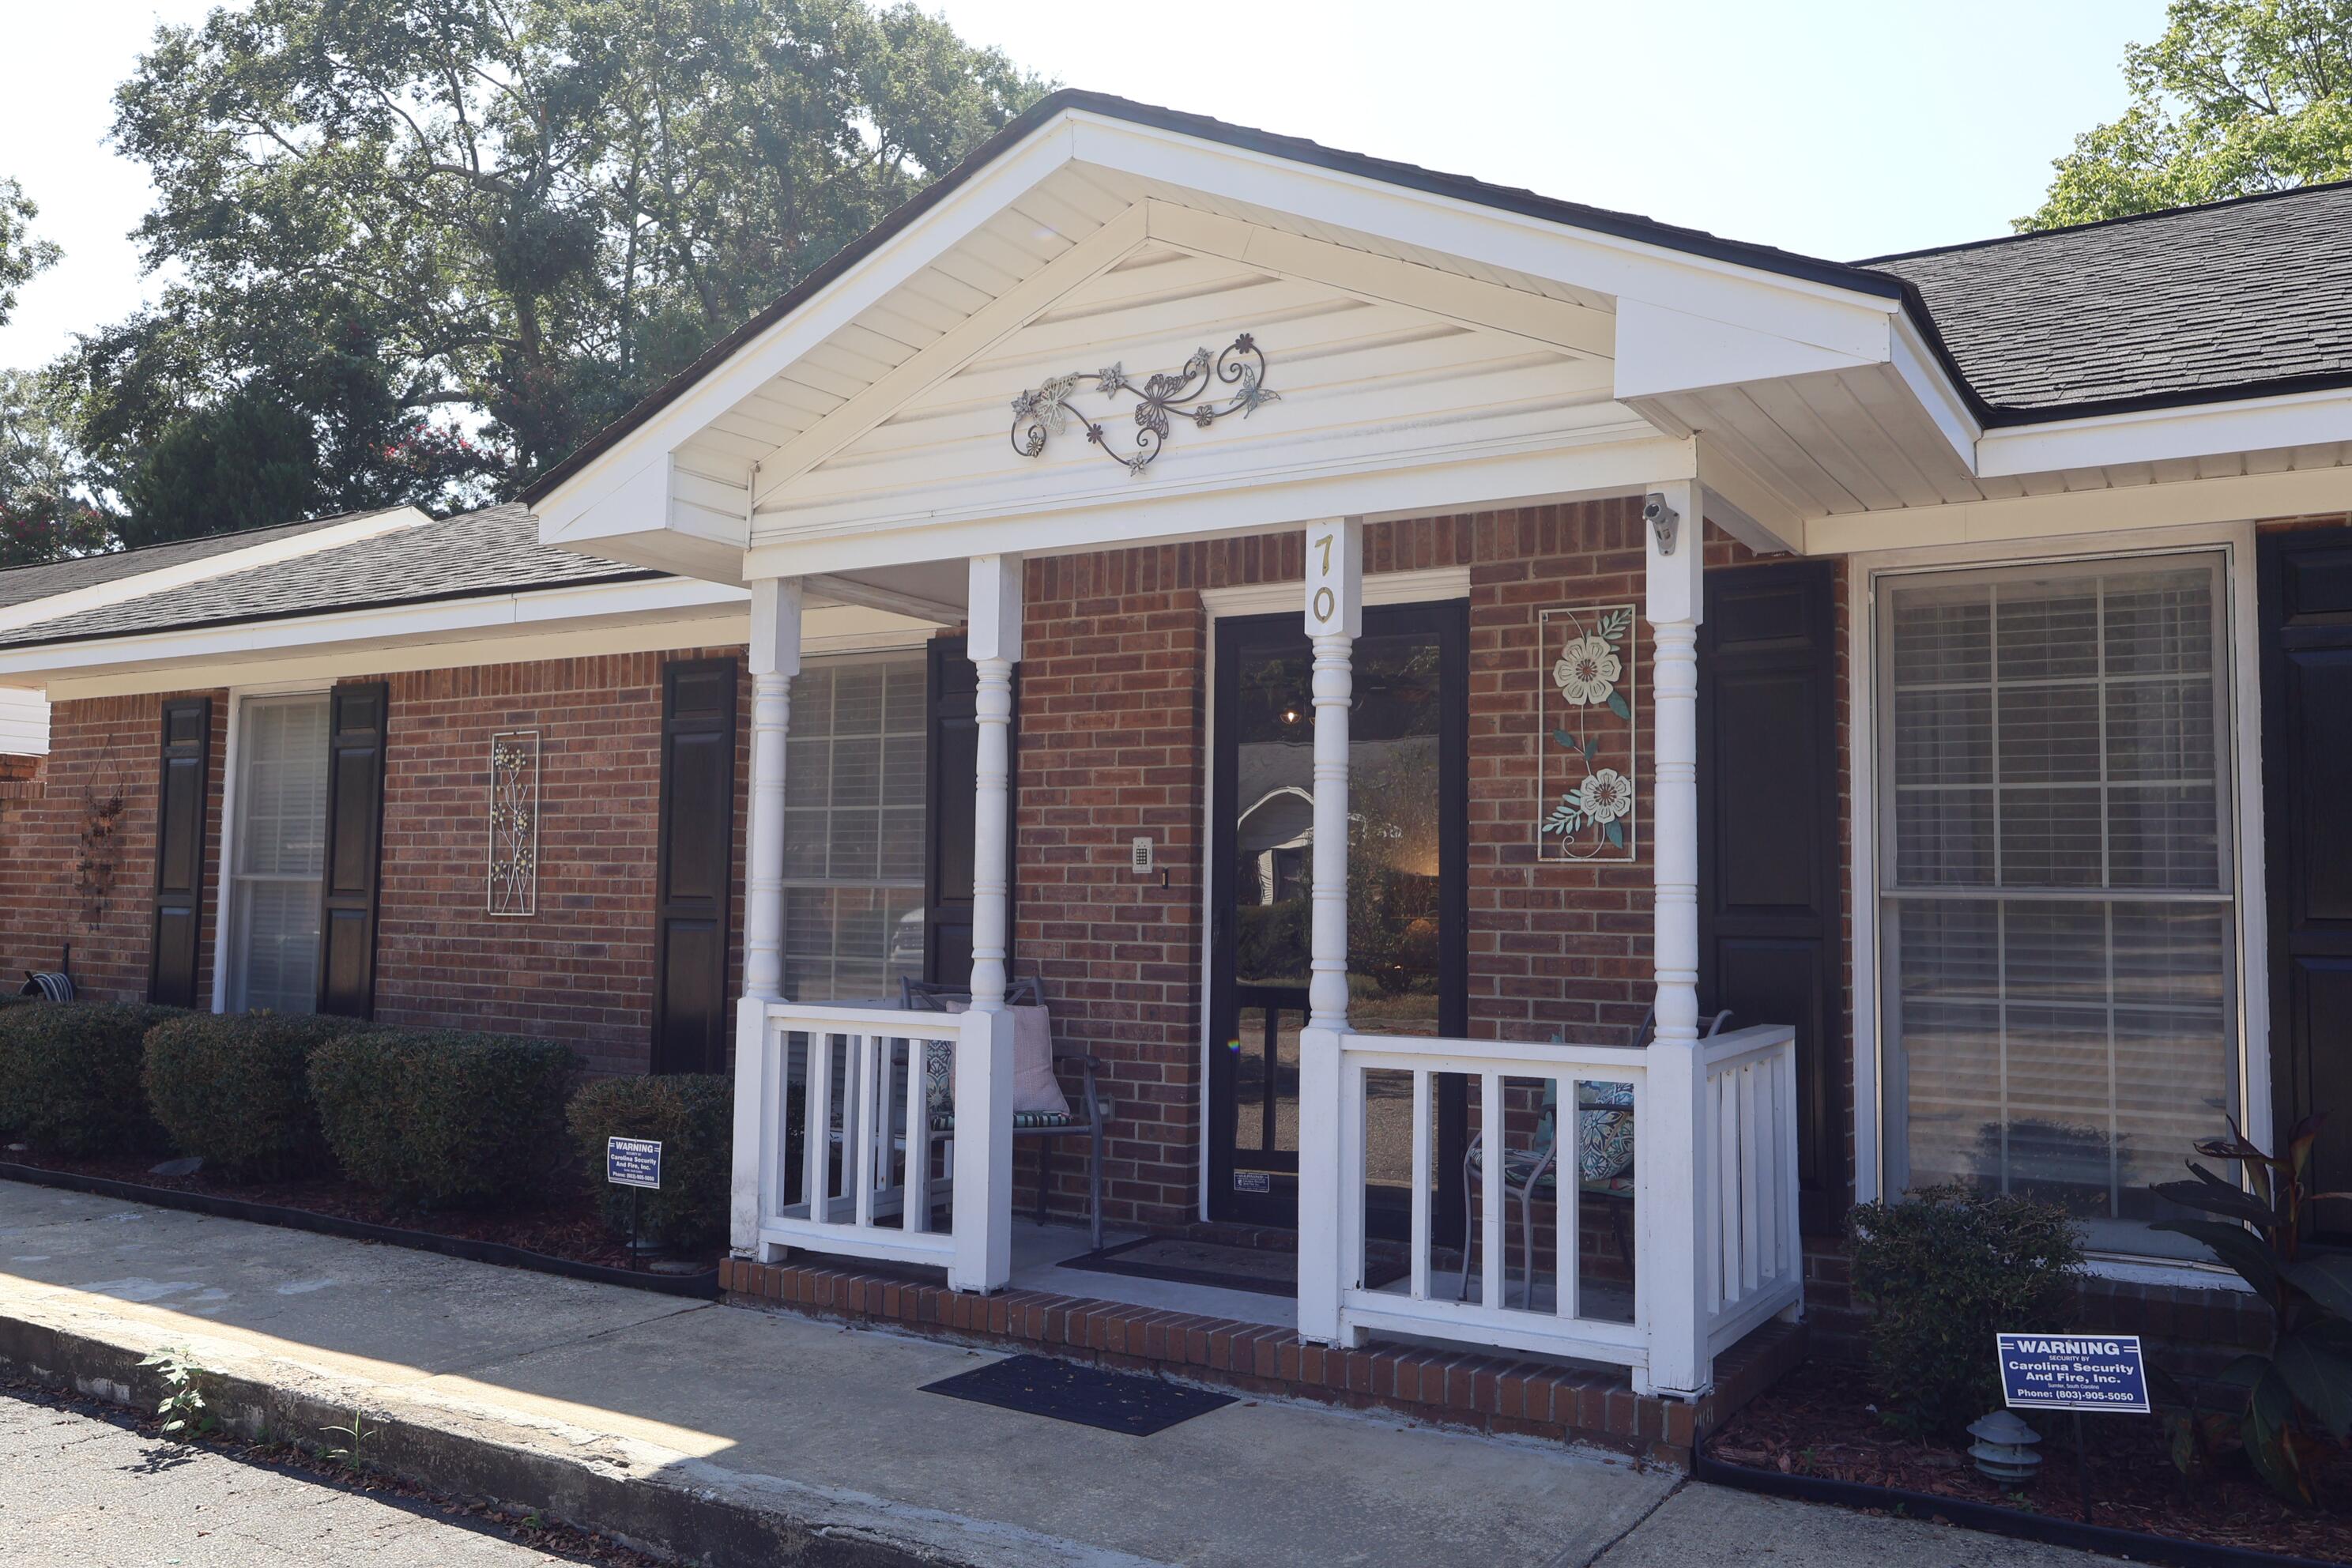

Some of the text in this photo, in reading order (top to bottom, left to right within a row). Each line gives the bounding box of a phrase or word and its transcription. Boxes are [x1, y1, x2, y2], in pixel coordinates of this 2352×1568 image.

[1314, 534, 1334, 624] 70
[616, 1141, 653, 1153] WARNING
[2017, 1340, 2120, 1355] WARNING
[2009, 1361, 2134, 1375] Carolina Security
[2058, 1374, 2089, 1383] Fire,
[2094, 1374, 2120, 1383] Inc.
[2056, 1390, 2134, 1400] (803)-905-5050
